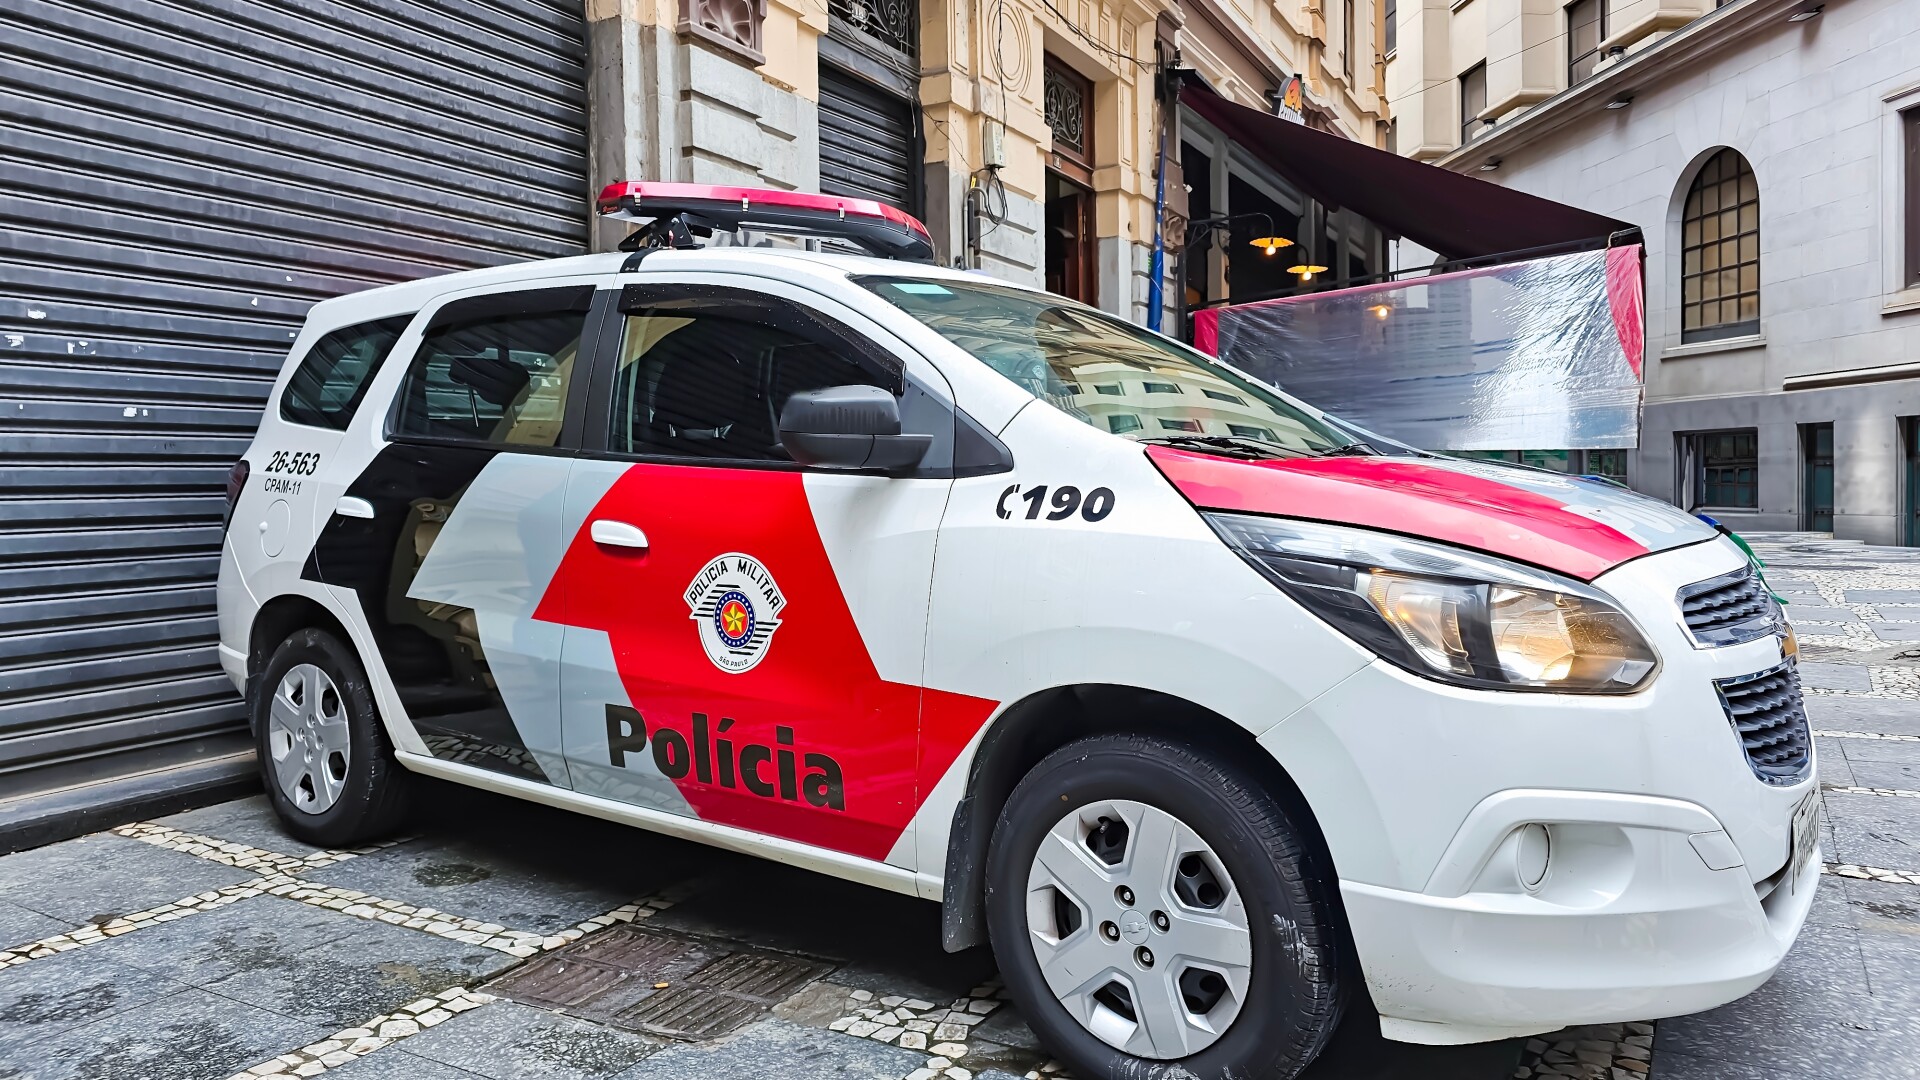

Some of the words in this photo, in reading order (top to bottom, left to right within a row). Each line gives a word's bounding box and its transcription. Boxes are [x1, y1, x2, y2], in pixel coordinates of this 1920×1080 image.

[265, 450, 320, 476] 26-563
[264, 478, 302, 495] CPAM-11
[1022, 485, 1115, 522] 190
[689, 560, 729, 604] POLICIA
[737, 559, 780, 610] MILITAR
[718, 655, 730, 666] SÃO
[730, 658, 748, 667] PAULO
[605, 703, 846, 812] Polícia
